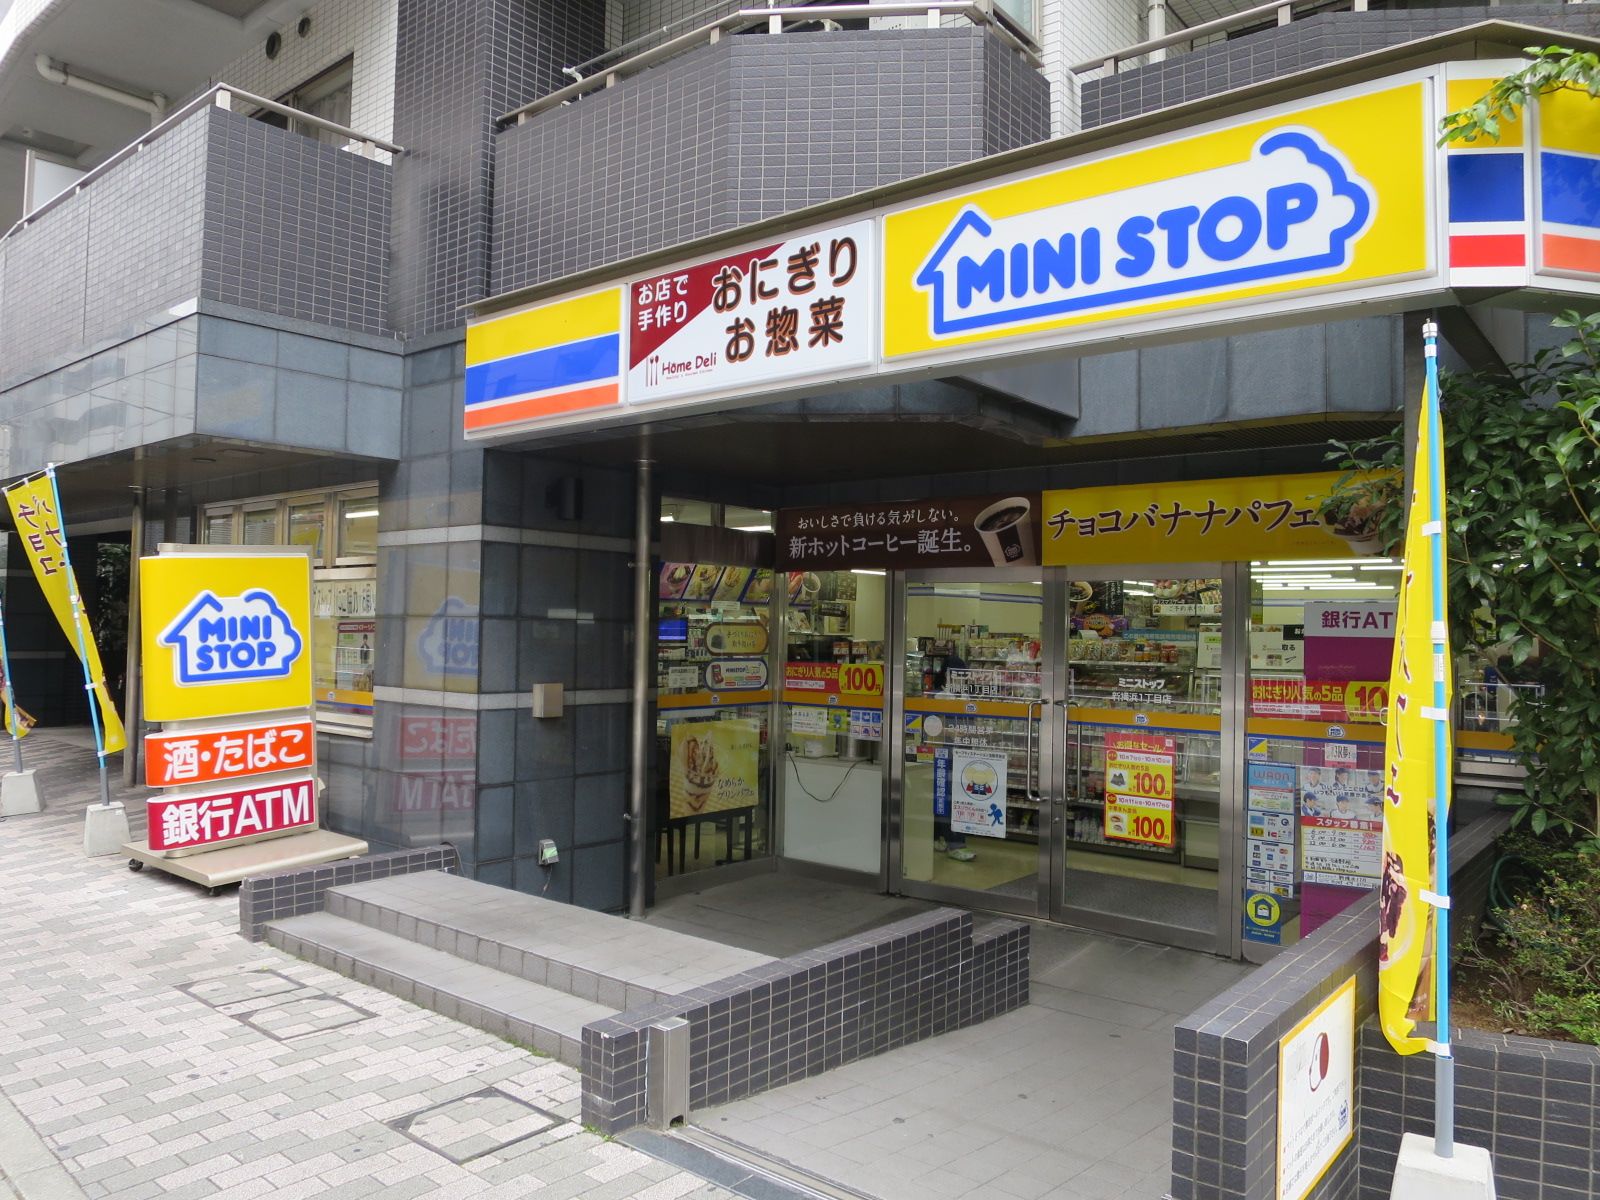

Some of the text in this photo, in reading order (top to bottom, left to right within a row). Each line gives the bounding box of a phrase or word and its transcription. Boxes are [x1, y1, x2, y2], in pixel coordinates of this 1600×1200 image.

[957, 182, 1319, 309] MINI STOP
[638, 273, 690, 304] お店で
[711, 236, 859, 314] おにぎり
[637, 301, 688, 332] 手作り
[725, 295, 846, 364] お惣菜
[661, 357, 692, 377] Home
[694, 352, 717, 371] Deli
[797, 507, 961, 530] おいしさで負ける気がしない。
[1047, 500, 1320, 541] チョコバナナパフェ
[789, 528, 972, 559] 新ホットコーヒー誕生。
[199, 614, 273, 643] MINI
[1321, 610, 1394, 629] 銀行AT
[196, 641, 277, 672] STOP
[1112, 692, 1172, 705] 新横浜1丁目店
[1118, 677, 1166, 690] ミニストップ
[1252, 685, 1344, 702] おにぎり人気の5品
[163, 728, 306, 782] 酒・たばこ
[161, 784, 311, 846] 銀行ATM
